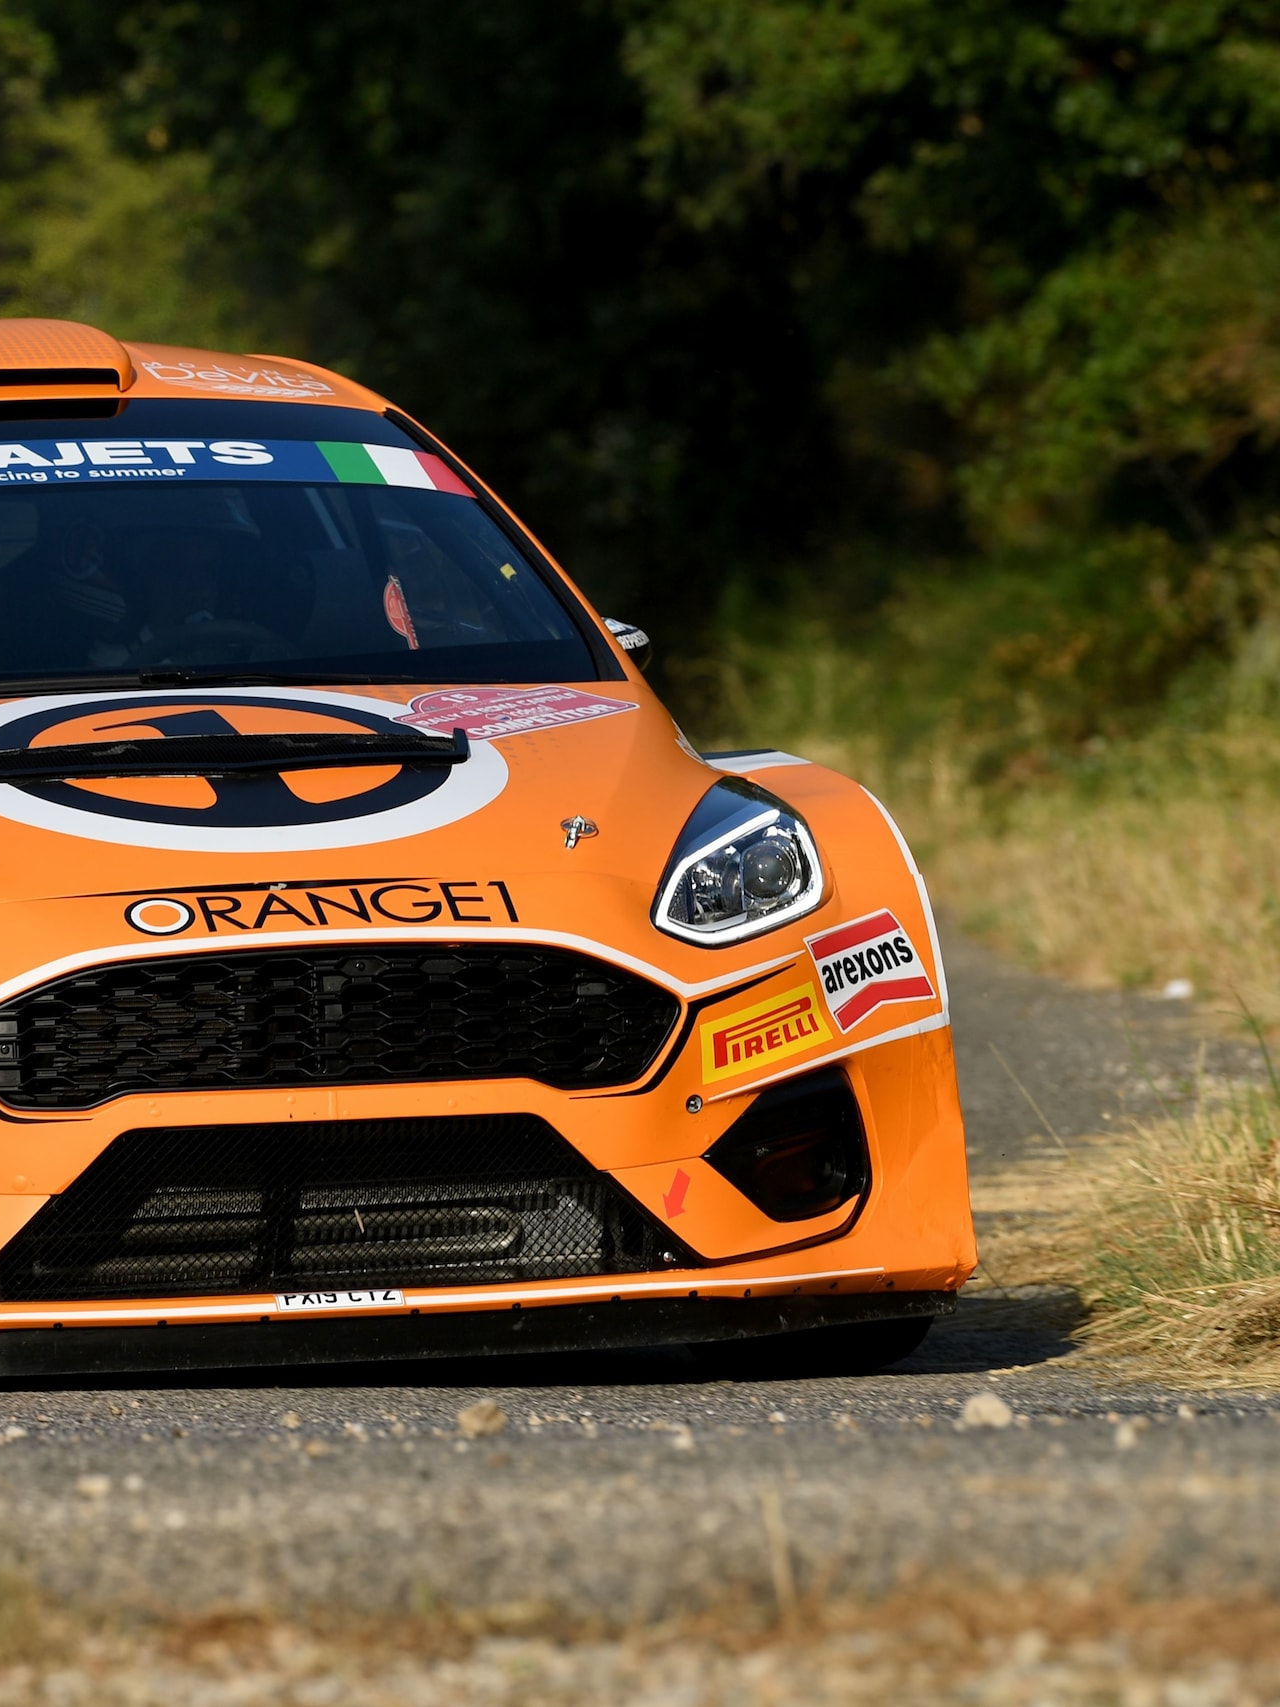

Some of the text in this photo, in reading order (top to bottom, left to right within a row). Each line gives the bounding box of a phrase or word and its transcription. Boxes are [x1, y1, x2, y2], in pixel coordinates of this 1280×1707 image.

[146, 364, 332, 392] DeVita
[55, 469, 81, 479] to
[88, 468, 187, 478] summer
[416, 712, 463, 726] RALLY
[467, 704, 614, 736] COMPETITOR
[124, 880, 520, 936] ORANGE1
[822, 936, 914, 994] arexons
[713, 996, 819, 1069] PIRELLI
